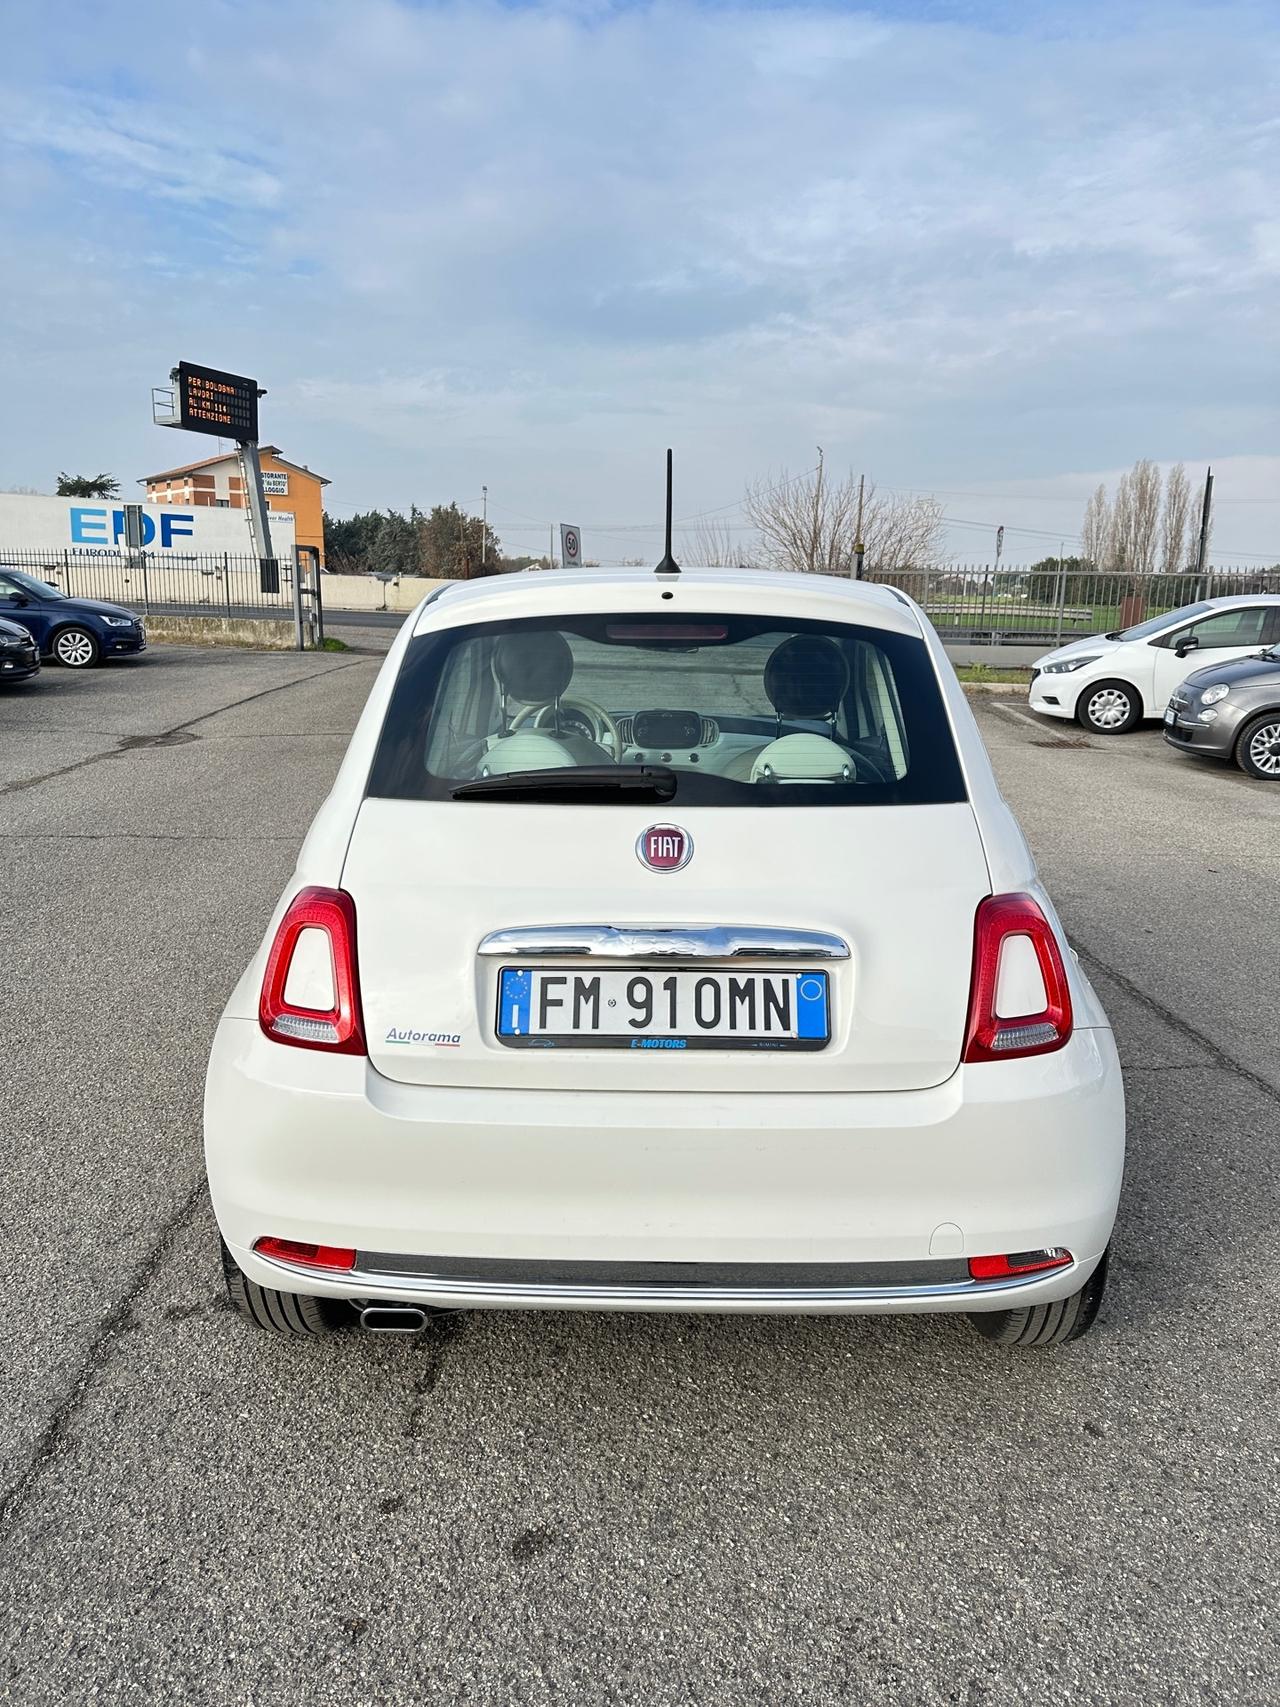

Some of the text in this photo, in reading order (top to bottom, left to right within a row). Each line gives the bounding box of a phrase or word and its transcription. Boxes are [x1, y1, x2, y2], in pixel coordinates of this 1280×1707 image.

[188, 376, 234, 395] PER BOLOGNA
[188, 387, 214, 400] LAVORI
[188, 397, 198, 406] AL
[202, 400, 211, 409] KM
[188, 407, 231, 424] ATTENZIONE
[261, 472, 287, 480] STORANTE
[569, 537, 576, 550] 50
[650, 836, 681, 858] FIAT
[539, 976, 600, 1029] FM
[627, 976, 791, 1031] 910MN
[386, 1027, 461, 1043] Autorama
[631, 1039, 688, 1049] E-MOTORS
